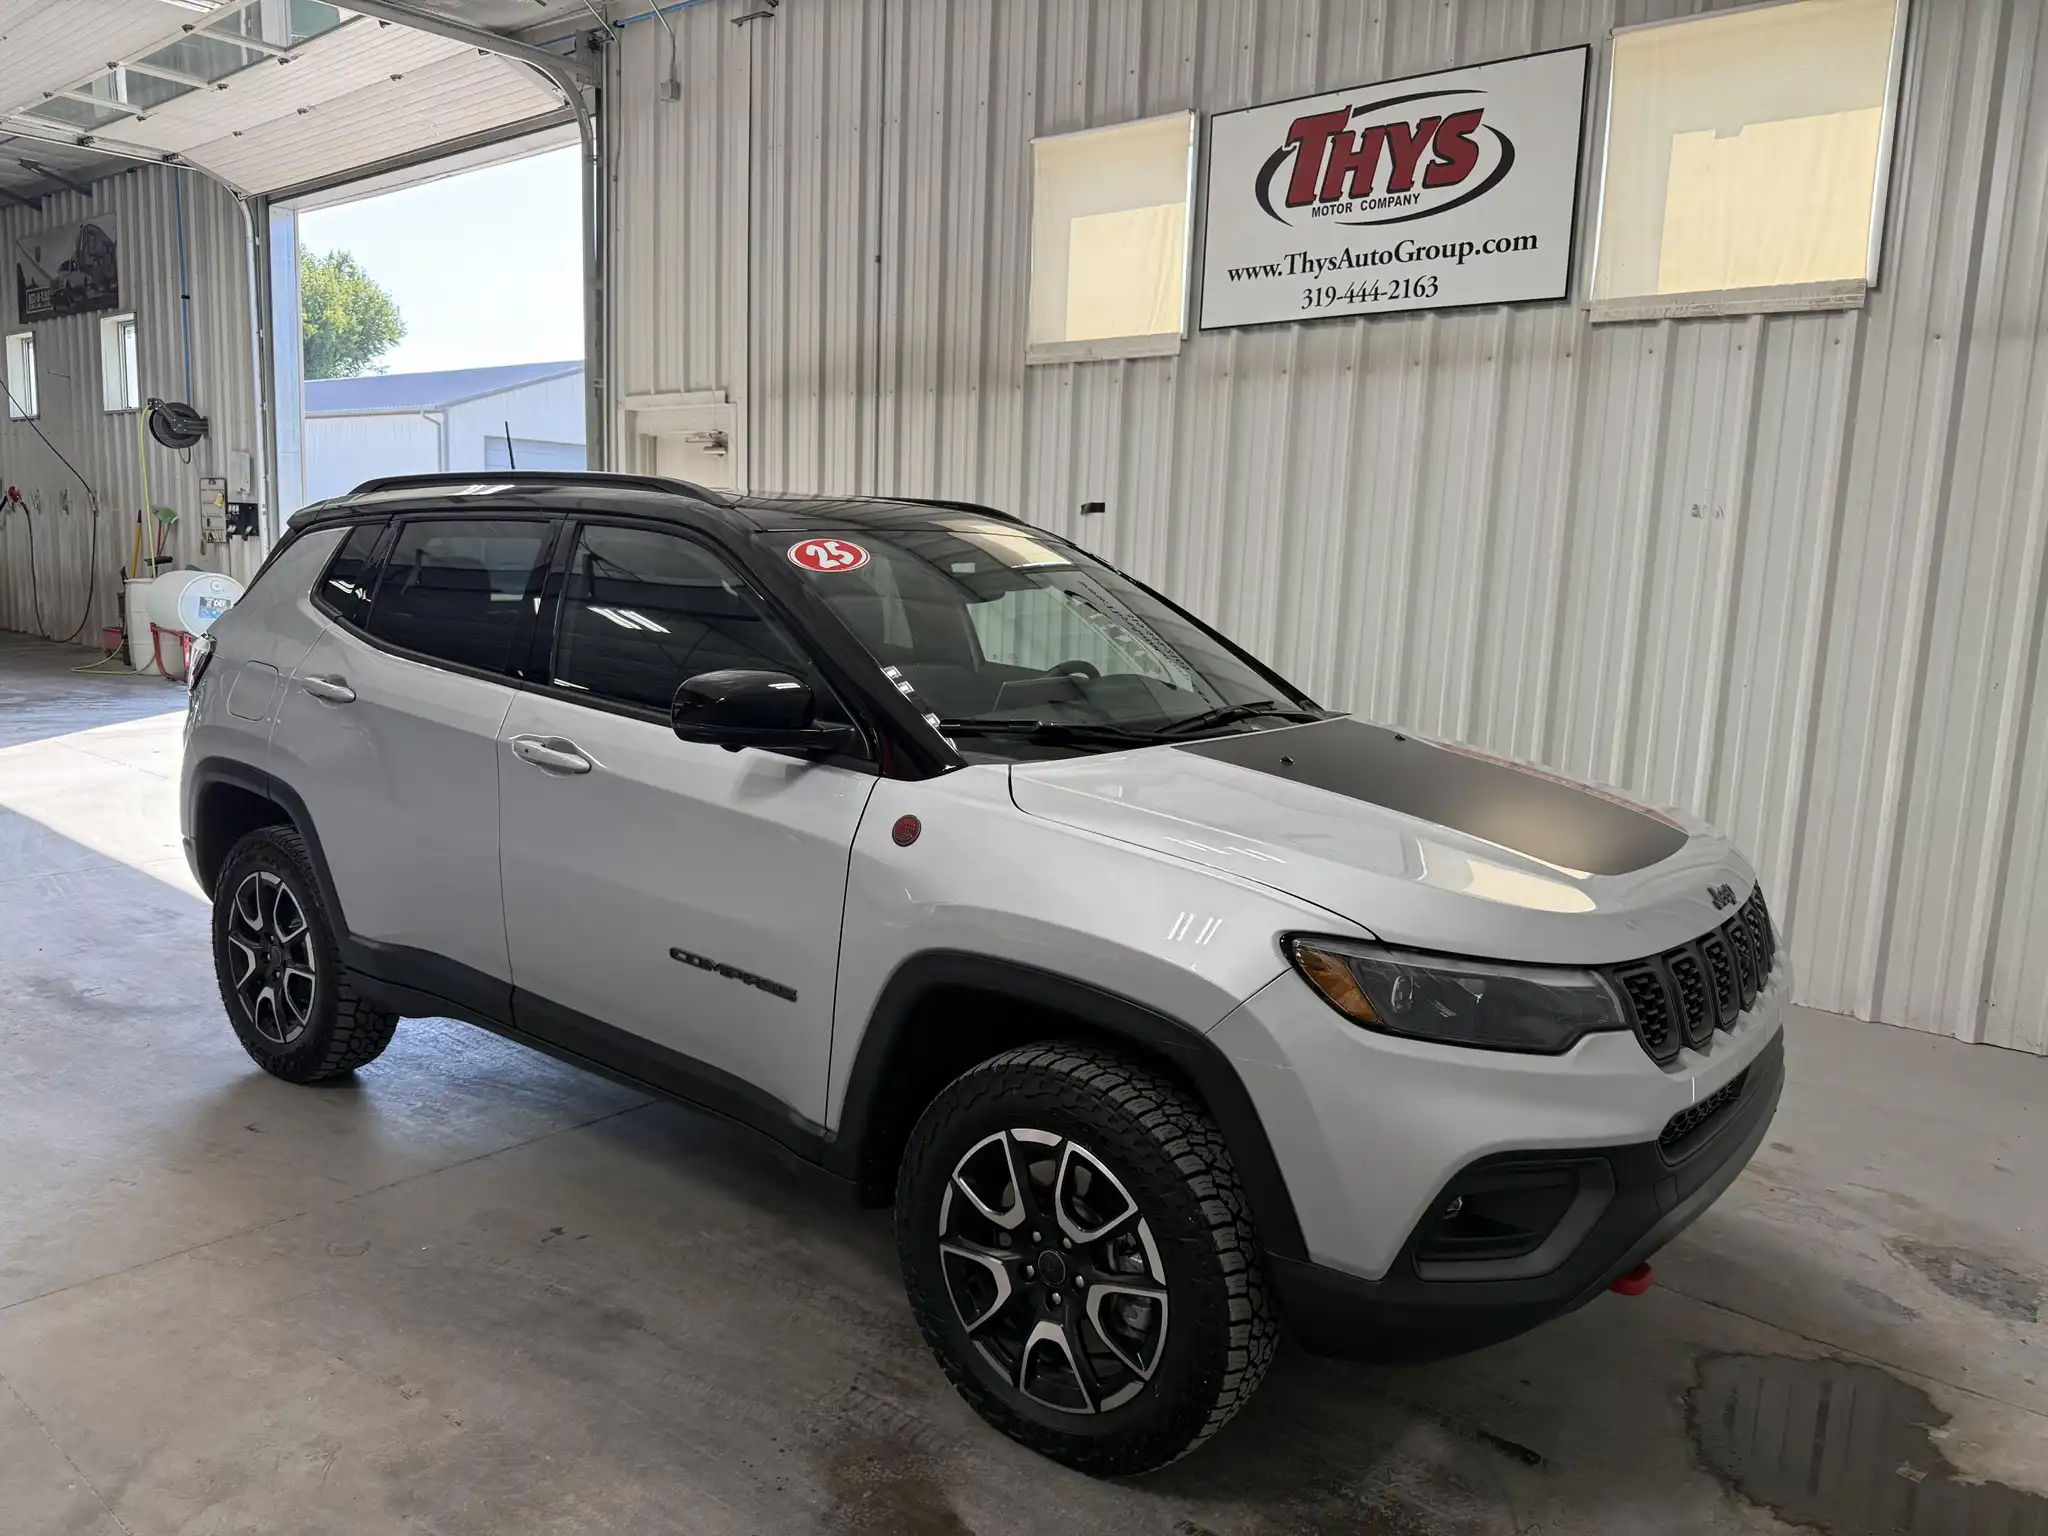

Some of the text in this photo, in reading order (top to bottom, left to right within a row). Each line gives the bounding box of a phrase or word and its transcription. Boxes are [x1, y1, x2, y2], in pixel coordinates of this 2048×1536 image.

[1285, 104, 1485, 208] THYS
[1311, 192, 1421, 218] MOTOR COMPANY
[1227, 233, 1538, 282] www.ThysAutoGroup.com
[1301, 275, 1439, 309] 319-444-2163
[806, 541, 854, 569] 25
